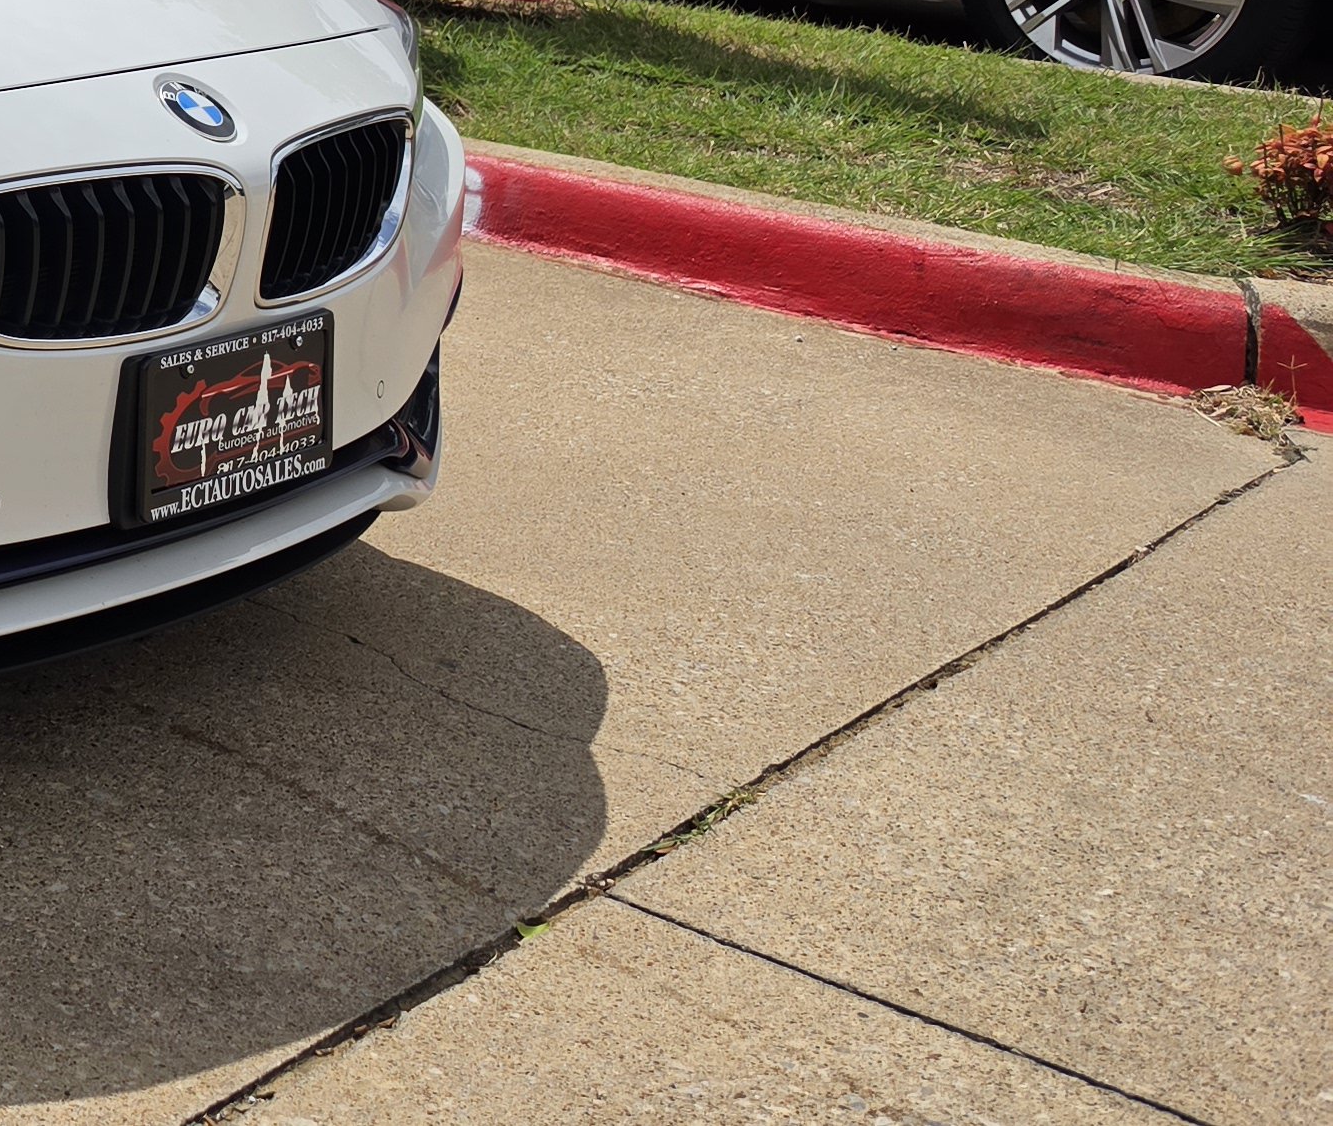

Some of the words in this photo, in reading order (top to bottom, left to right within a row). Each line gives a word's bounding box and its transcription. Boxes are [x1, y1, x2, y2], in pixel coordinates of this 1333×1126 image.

[160, 351, 192, 370] SALES
[194, 348, 203, 362] &
[205, 337, 250, 359] SERVICE
[261, 316, 324, 345] 817-404-4033
[171, 413, 226, 454] EURO
[232, 402, 270, 437] CAR
[275, 385, 320, 424] TECH
[218, 428, 265, 452] european
[266, 413, 318, 438] automotive
[150, 453, 326, 522] www.ECTAUTOSALES.com
